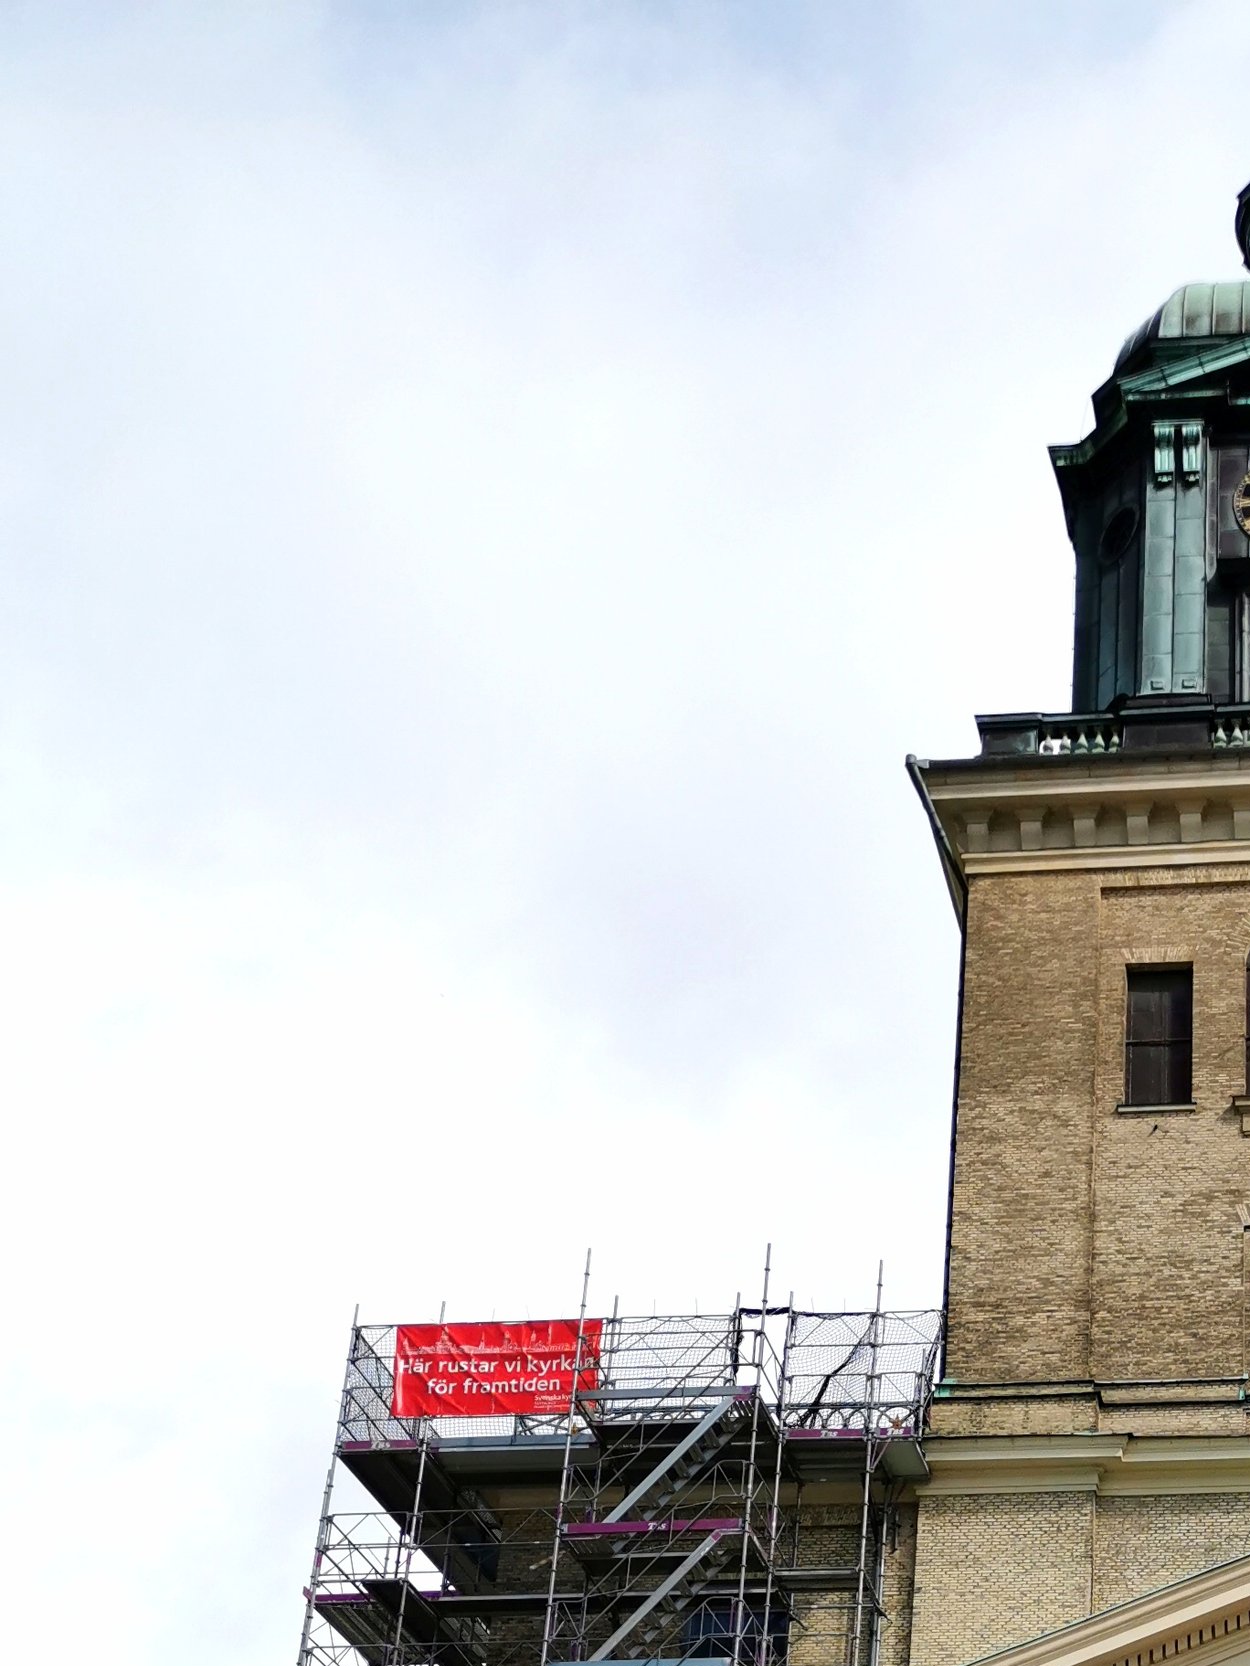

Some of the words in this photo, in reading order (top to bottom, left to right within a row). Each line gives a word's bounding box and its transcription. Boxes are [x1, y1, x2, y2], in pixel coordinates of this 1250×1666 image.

[400, 1356, 432, 1374] Här
[438, 1359, 497, 1374] rustar
[504, 1358, 521, 1372] vi
[427, 1377, 457, 1395] för
[463, 1376, 560, 1394] framtiden
